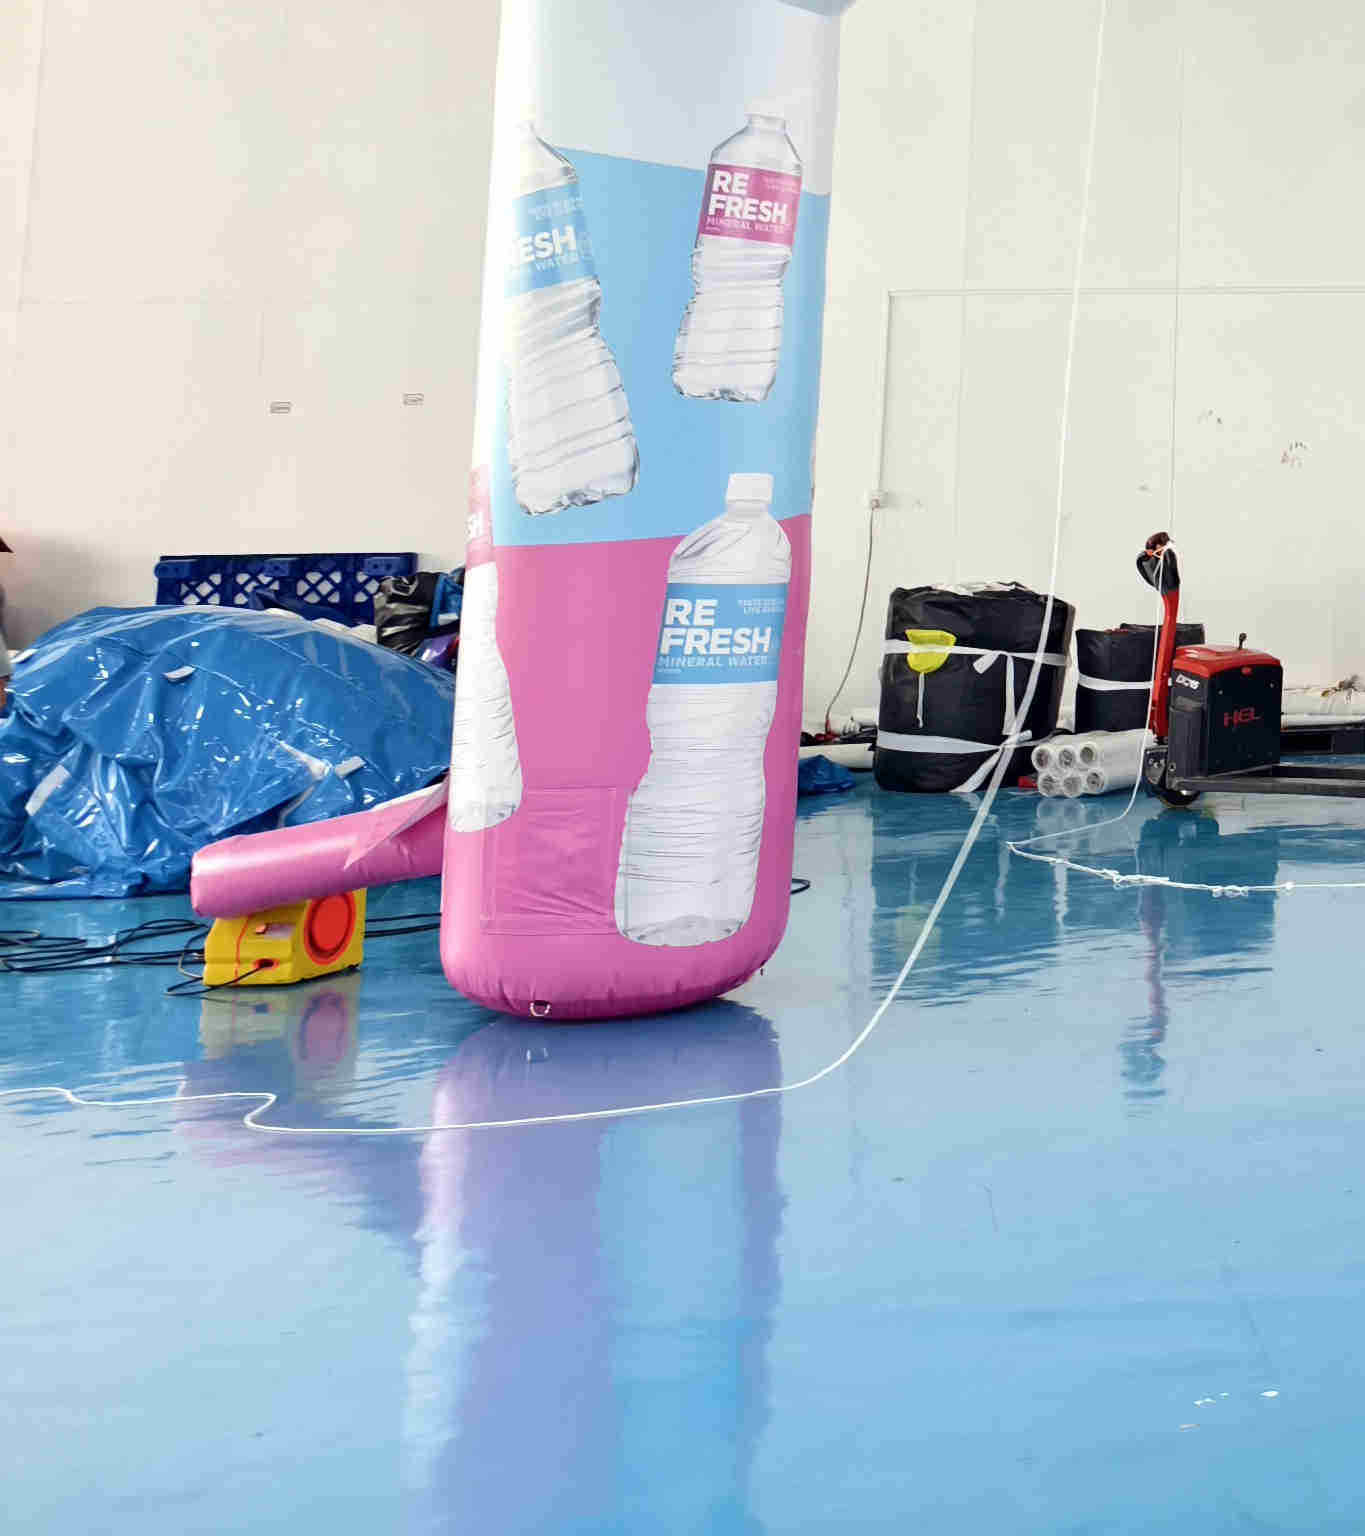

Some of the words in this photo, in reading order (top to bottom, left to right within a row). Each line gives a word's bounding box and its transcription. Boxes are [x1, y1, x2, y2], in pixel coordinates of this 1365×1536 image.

[712, 170, 749, 196] RE
[707, 193, 789, 225] FRESH
[664, 598, 719, 626] RE
[659, 626, 772, 656] FRESH
